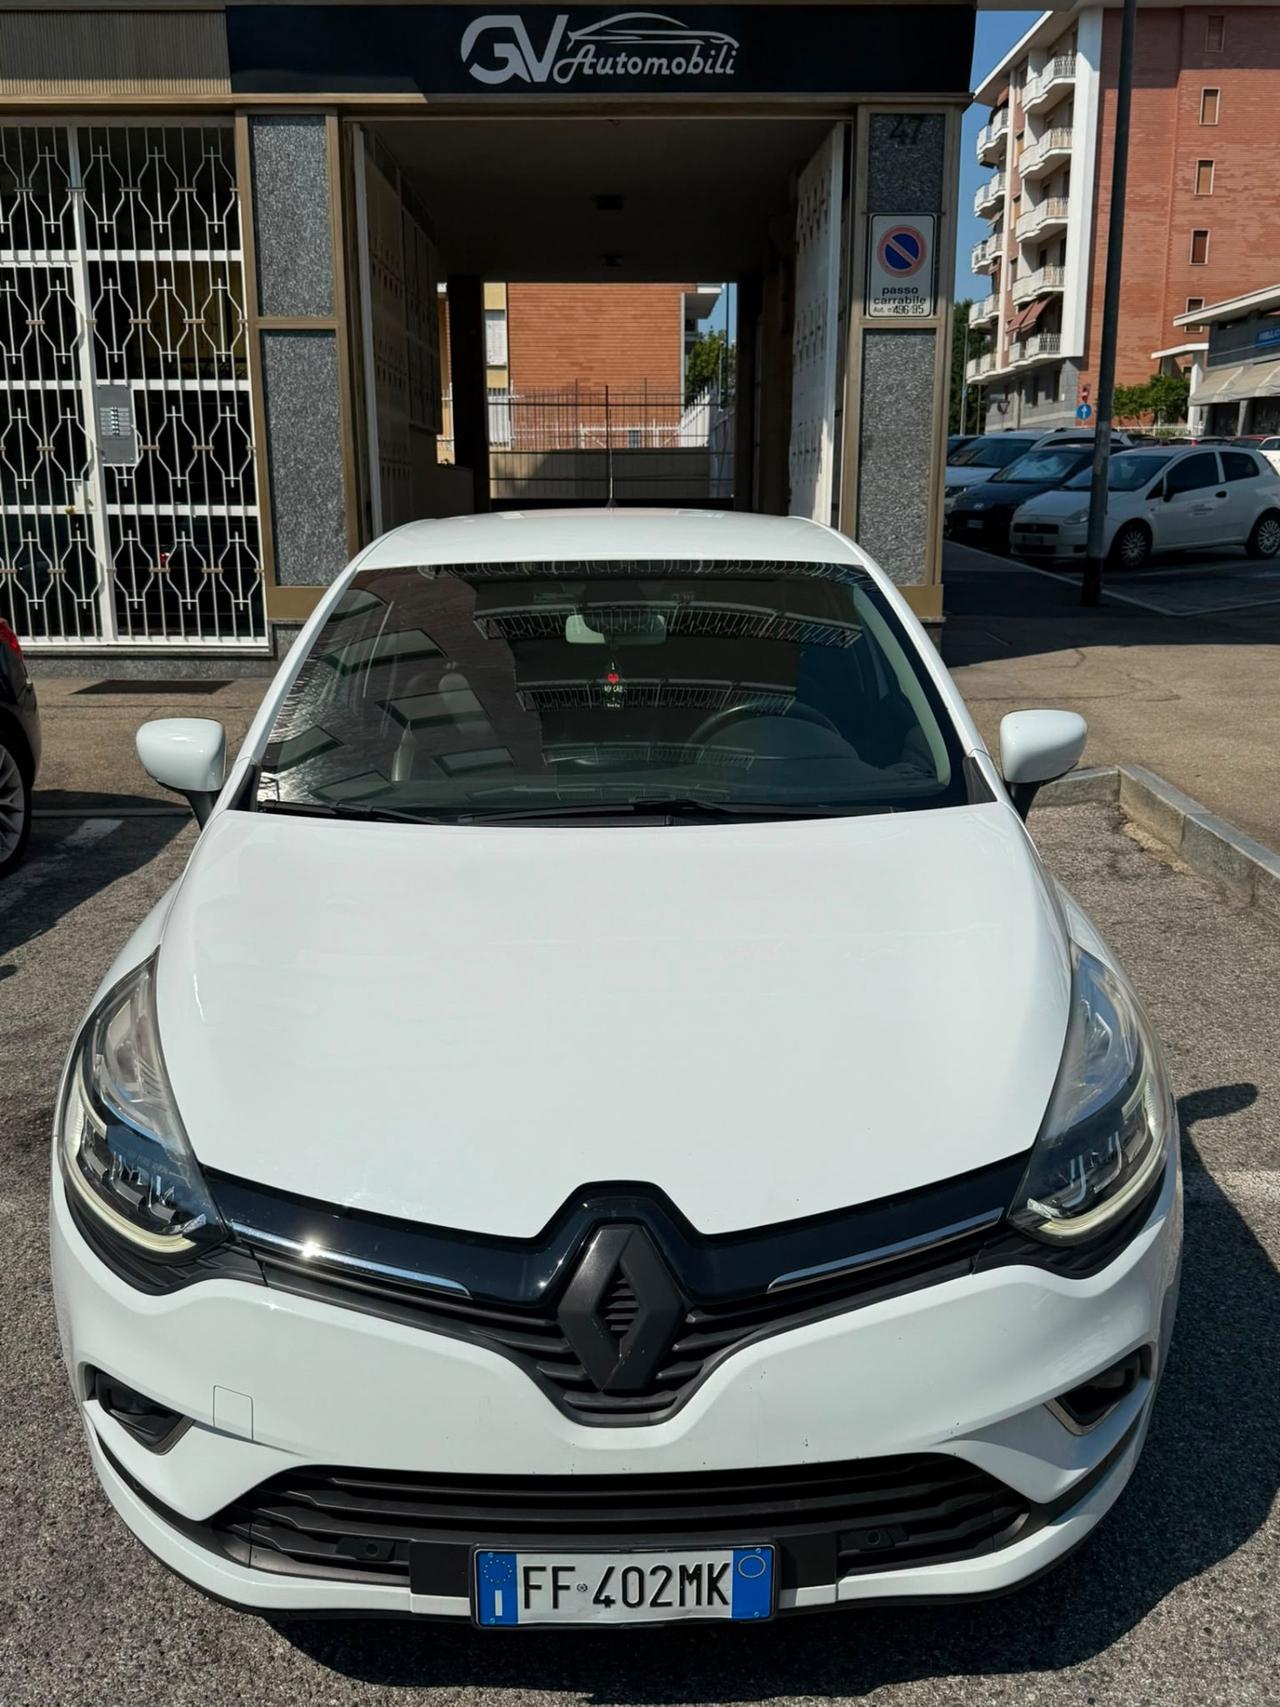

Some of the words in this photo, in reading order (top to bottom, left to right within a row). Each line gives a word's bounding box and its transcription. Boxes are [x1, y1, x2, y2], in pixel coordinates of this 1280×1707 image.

[460, 14, 570, 84] GV
[552, 43, 738, 84] Automobili
[882, 287, 919, 297] passo
[873, 296, 927, 305] carrabile
